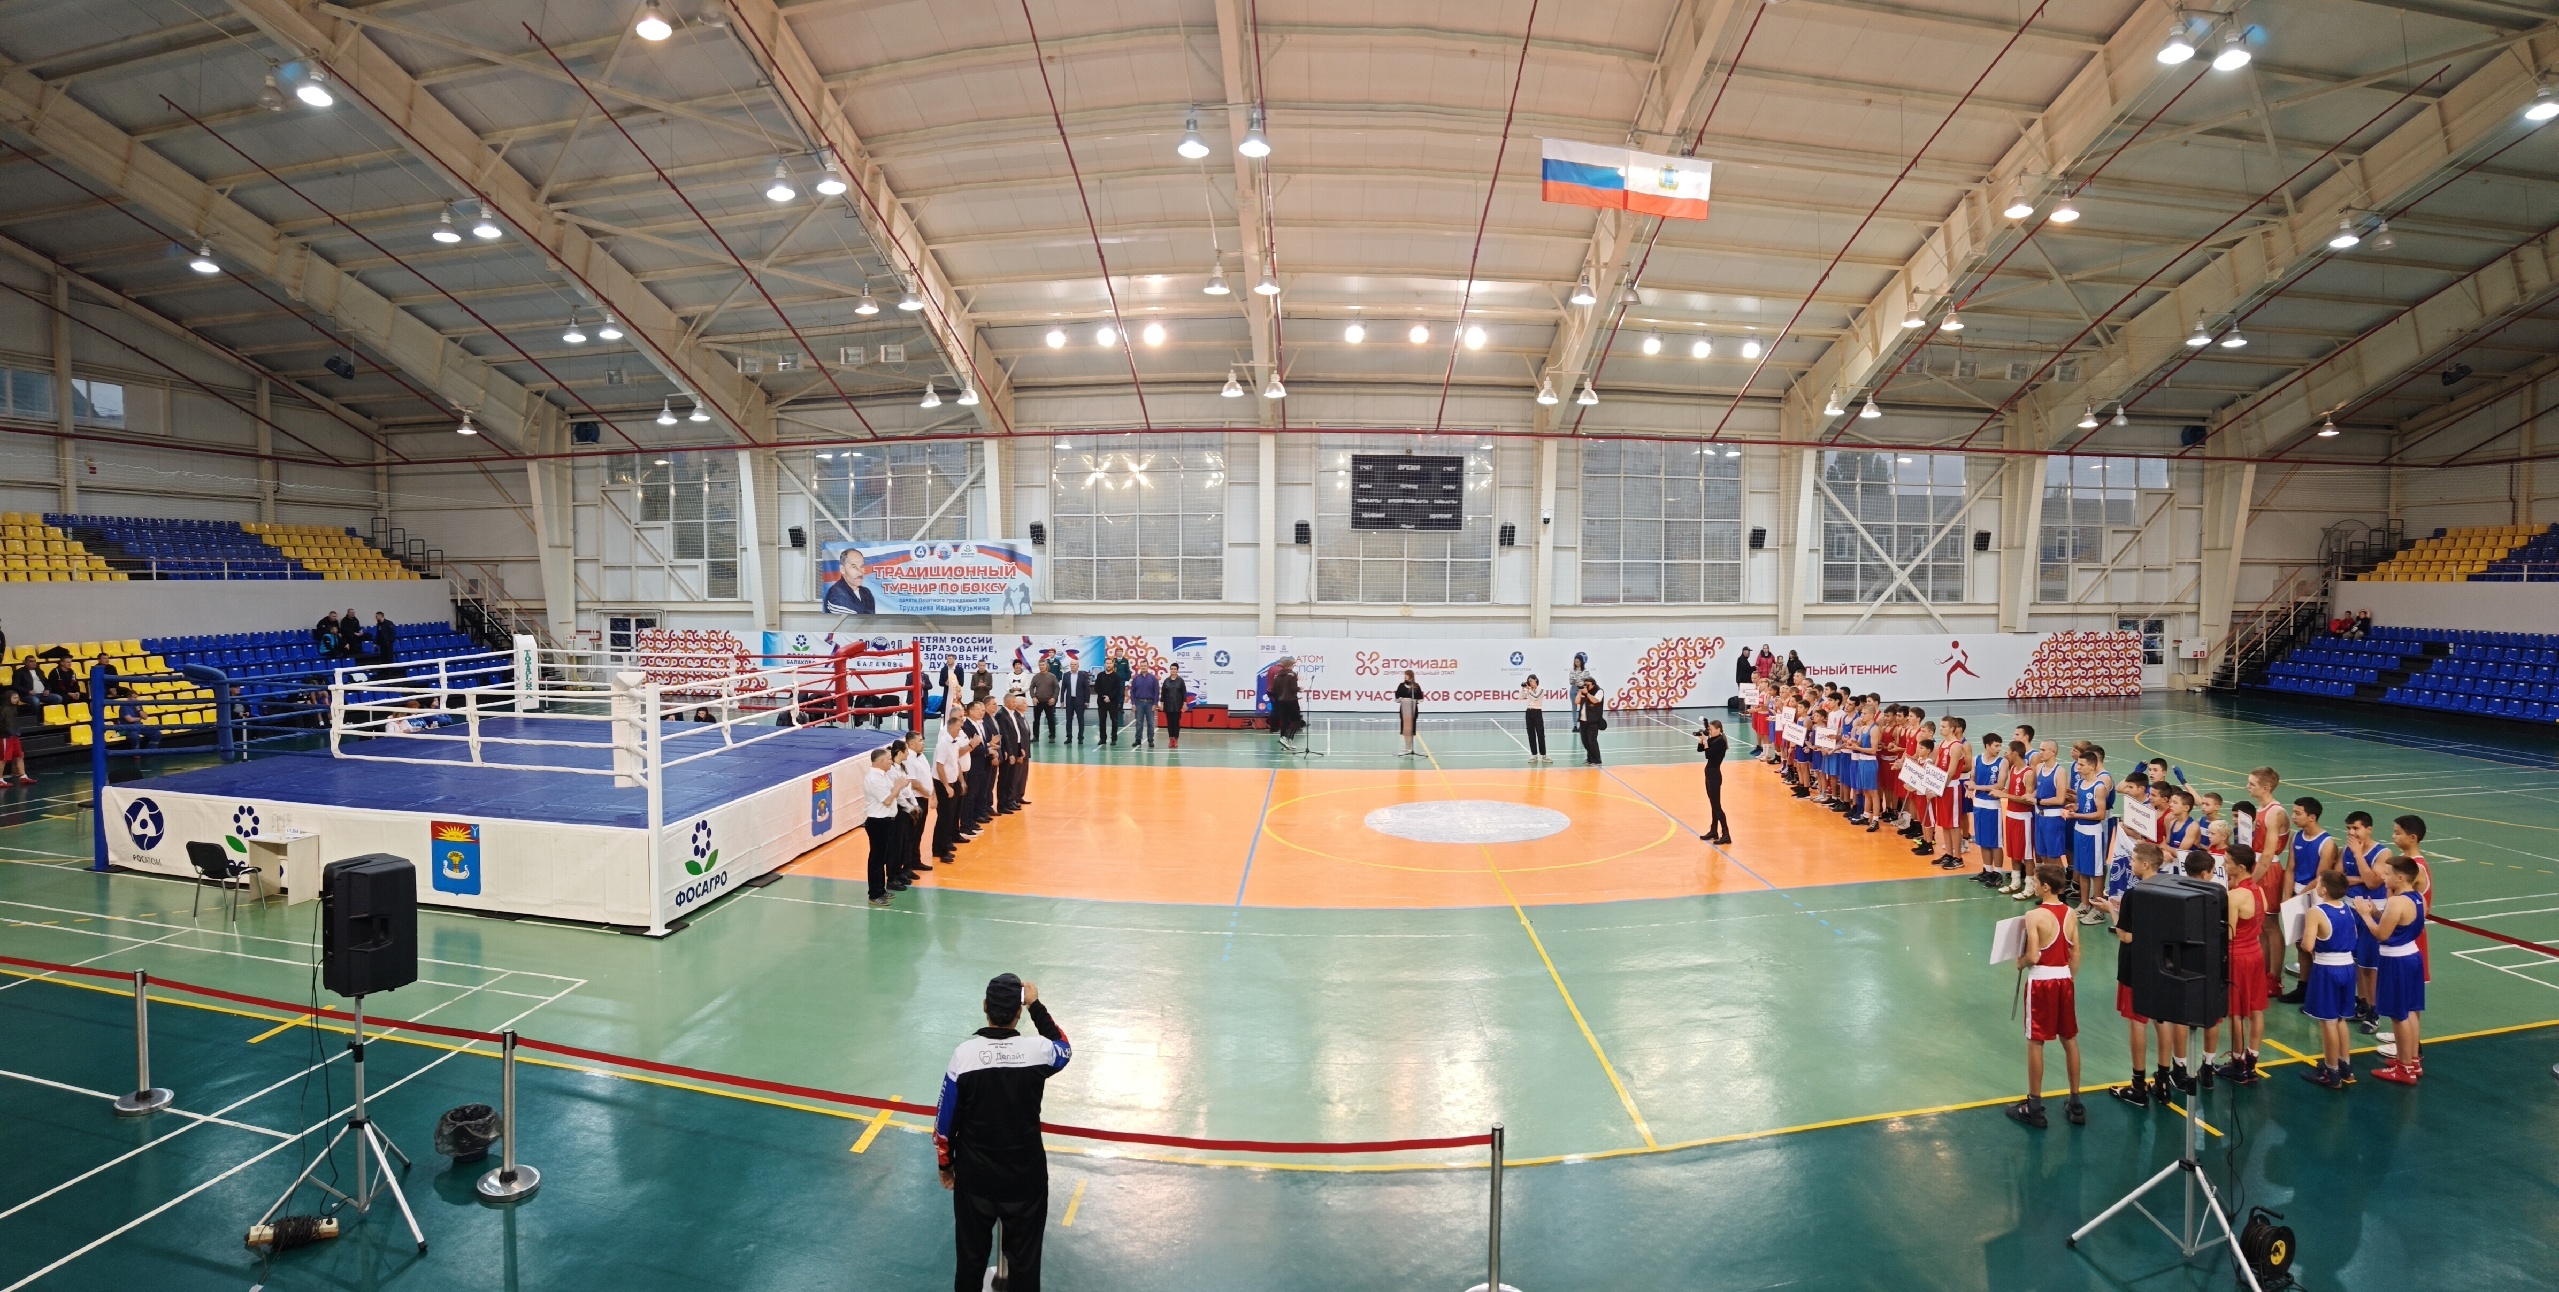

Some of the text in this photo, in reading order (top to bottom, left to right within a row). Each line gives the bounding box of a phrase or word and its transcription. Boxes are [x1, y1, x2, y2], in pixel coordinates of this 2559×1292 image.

[872, 562, 1016, 580] ТРАДИЦИОННЫЙ
[882, 582, 1007, 595] ТУРНИР ПО БОКСУ
[920, 645, 997, 653] ОБРАЗОВАНИЕ,
[1296, 655, 1324, 663] АТОМ
[1382, 659, 1458, 668] атомиада
[1806, 663, 1897, 675] ЛЬНЫЙ ТЕННИС
[1237, 688, 1568, 701] ПРТВУЕМ УЧАСКОВ СОРЕВНОНИЙ
[132, 854, 161, 866] РОСАТОМ
[675, 870, 728, 907] ФОСАГРО
